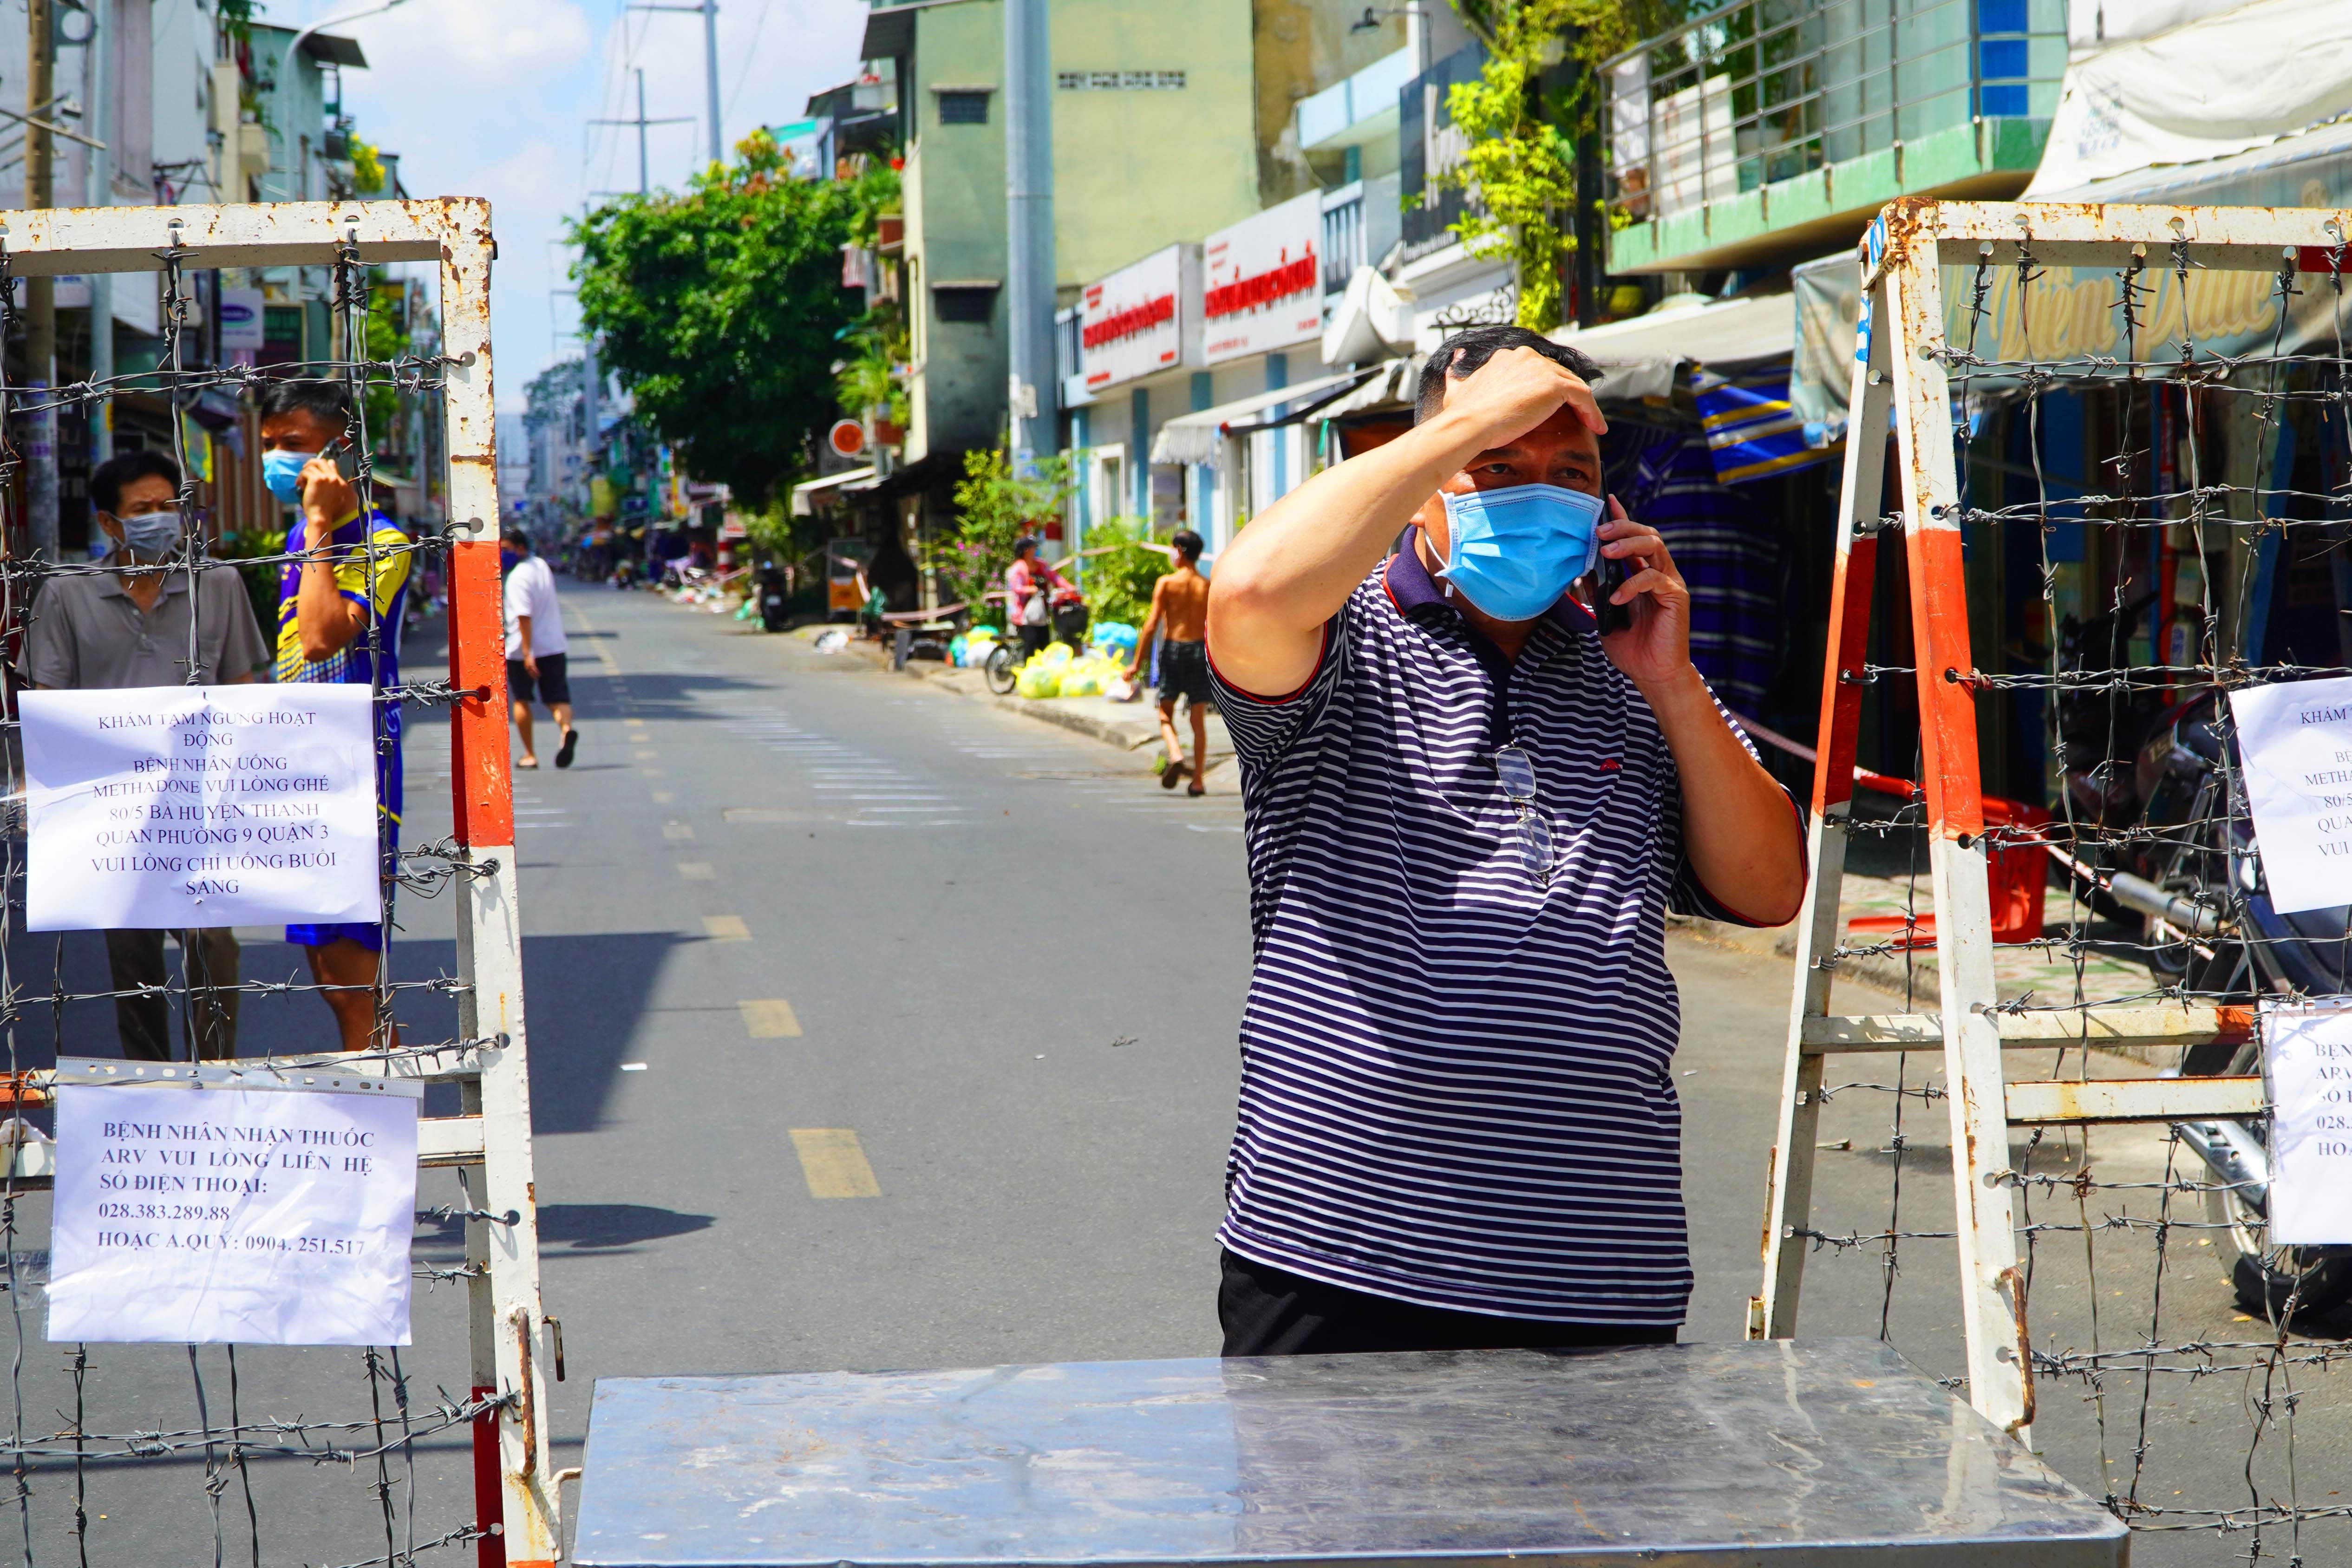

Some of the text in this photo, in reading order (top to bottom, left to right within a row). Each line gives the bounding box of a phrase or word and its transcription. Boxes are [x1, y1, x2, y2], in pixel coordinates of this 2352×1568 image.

[98, 712, 316, 729] KHÁM TẠM NGƯNG HOẠT
[2300, 706, 2347, 725] KHÁM
[184, 730, 234, 749] ĐỘNG
[133, 753, 287, 775] BỆNH NHÂN UỐNG
[94, 775, 329, 798] METHADONE VUI LÒNG GHÉ
[2304, 769, 2352, 786] METH
[110, 801, 320, 822] 80/5 BÀ HUYỆN THANH
[97, 822, 328, 847] QUAN PHƯỜNG 9 QUẬN 3
[2319, 841, 2349, 856] VUI
[92, 848, 337, 872] VUI LÒNG CHỈ UỐNG BUỔI
[186, 876, 240, 896] SÁNG
[2317, 1116, 2352, 1130] 028.
[103, 1121, 374, 1147] BỆNH NHÂN NHẬN THUỐC
[2318, 1142, 2352, 1156] HO
[101, 1148, 372, 1176] ARV VUI LÒNG LIÊN HỆ
[100, 1170, 266, 1197] SỐ ĐIỆN THOẠI:
[98, 1203, 229, 1221] 028.383.289.88
[98, 1230, 160, 1251] HOẶC
[245, 1235, 291, 1251] 0904.
[298, 1237, 365, 1254] 251.517
